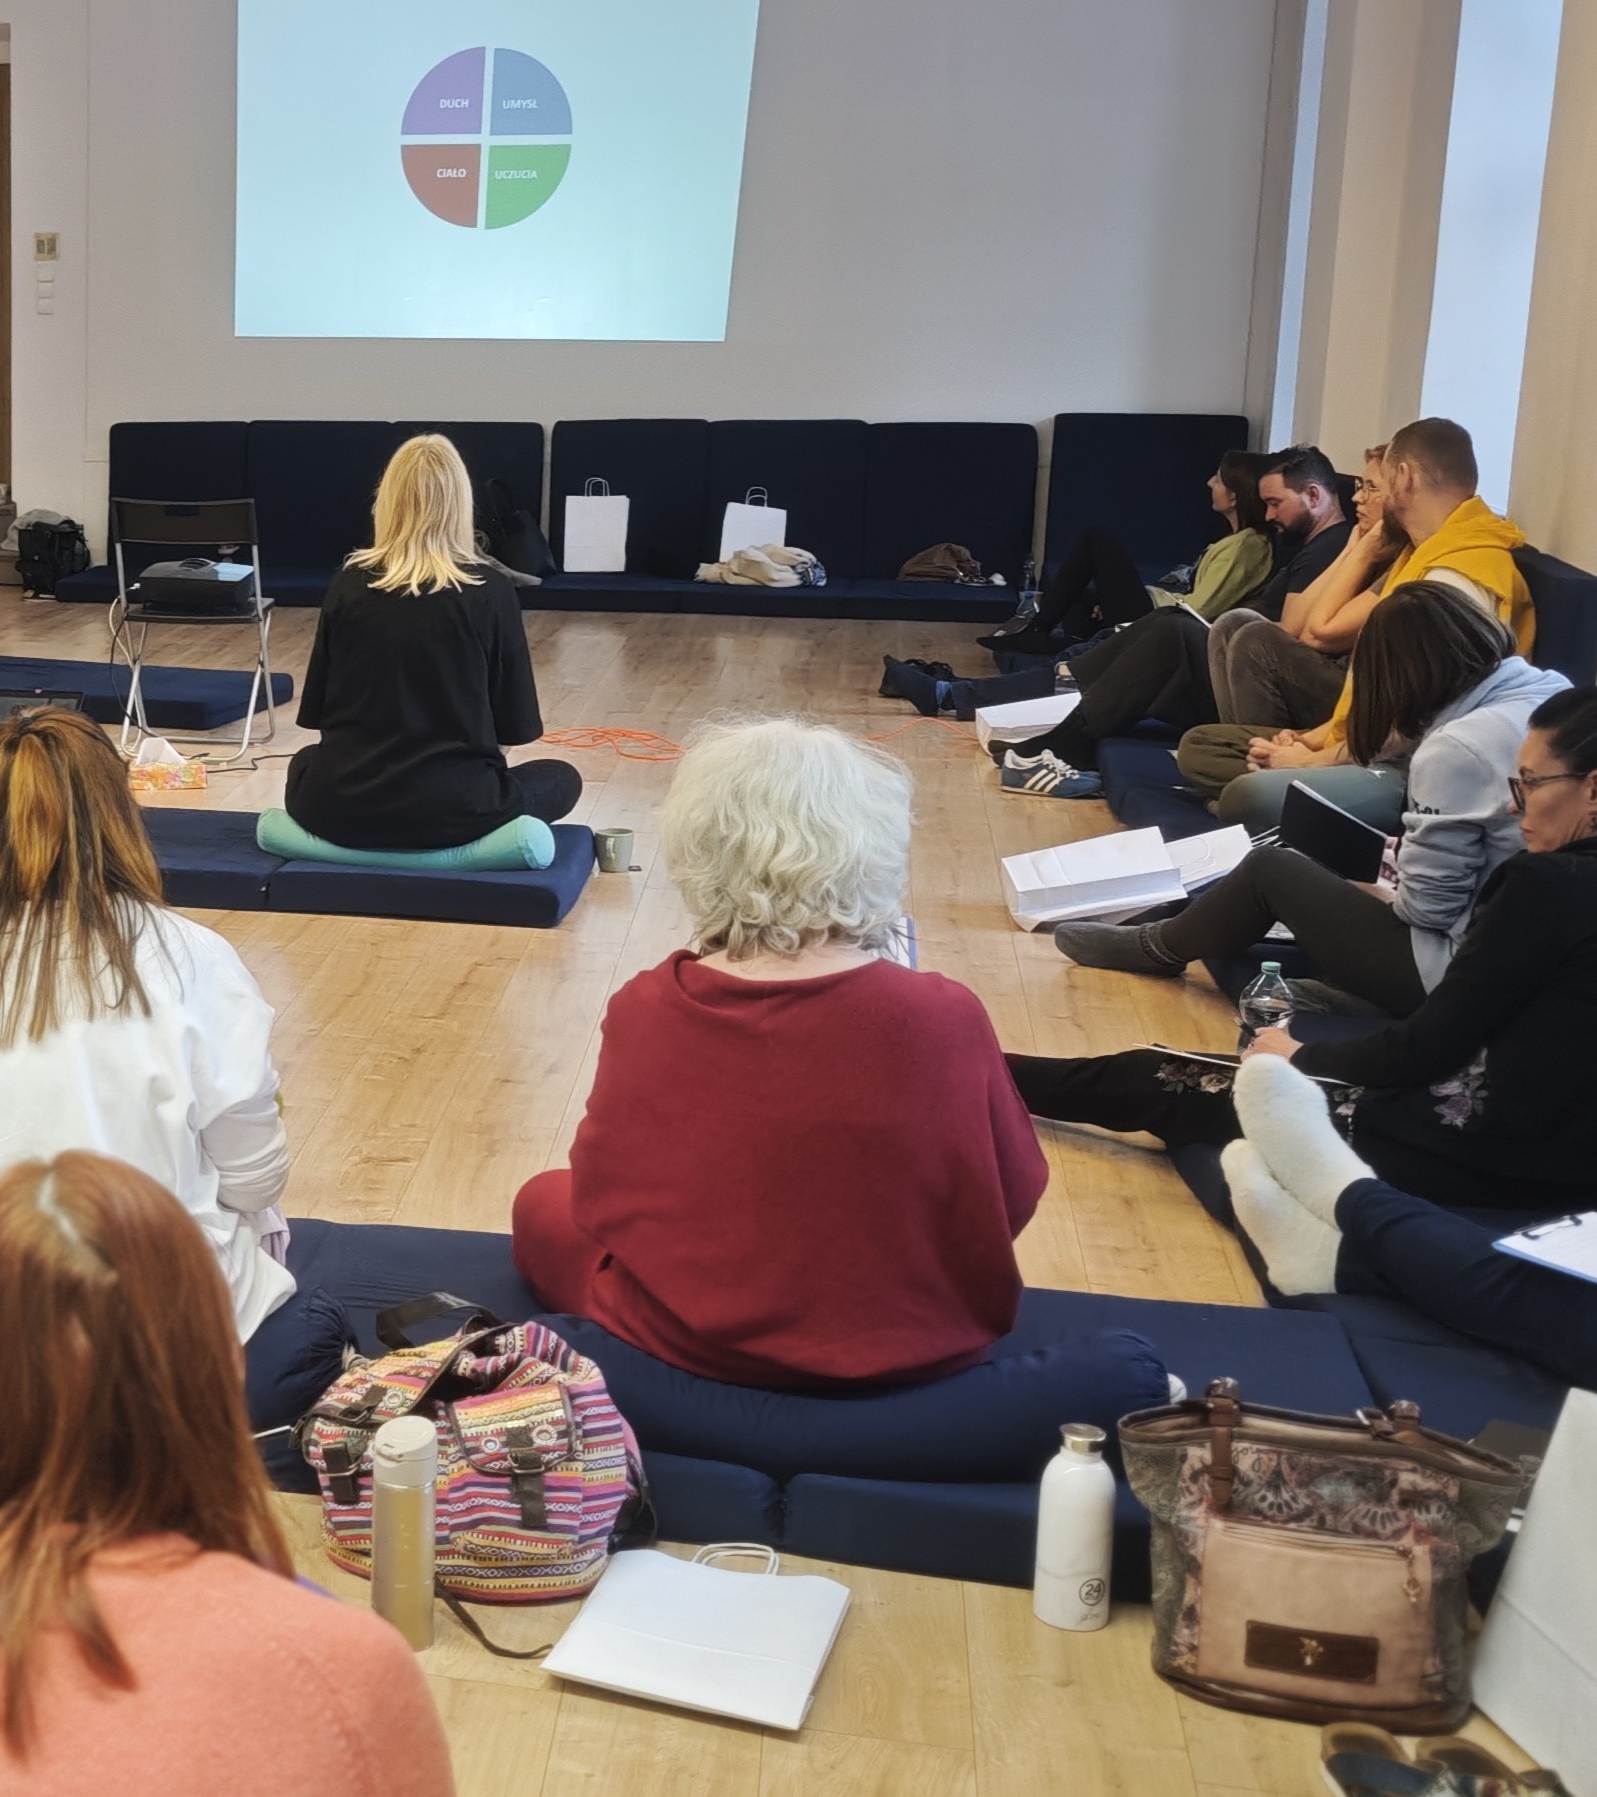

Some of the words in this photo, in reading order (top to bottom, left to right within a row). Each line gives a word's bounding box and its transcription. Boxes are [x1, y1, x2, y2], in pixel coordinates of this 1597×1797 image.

[439, 98, 469, 109] DUCH
[502, 98, 538, 110] UMYSŁ
[436, 168, 467, 178] CIAŁO
[494, 169, 538, 179] UCZUCIA
[1085, 1583, 1101, 1596] 24
